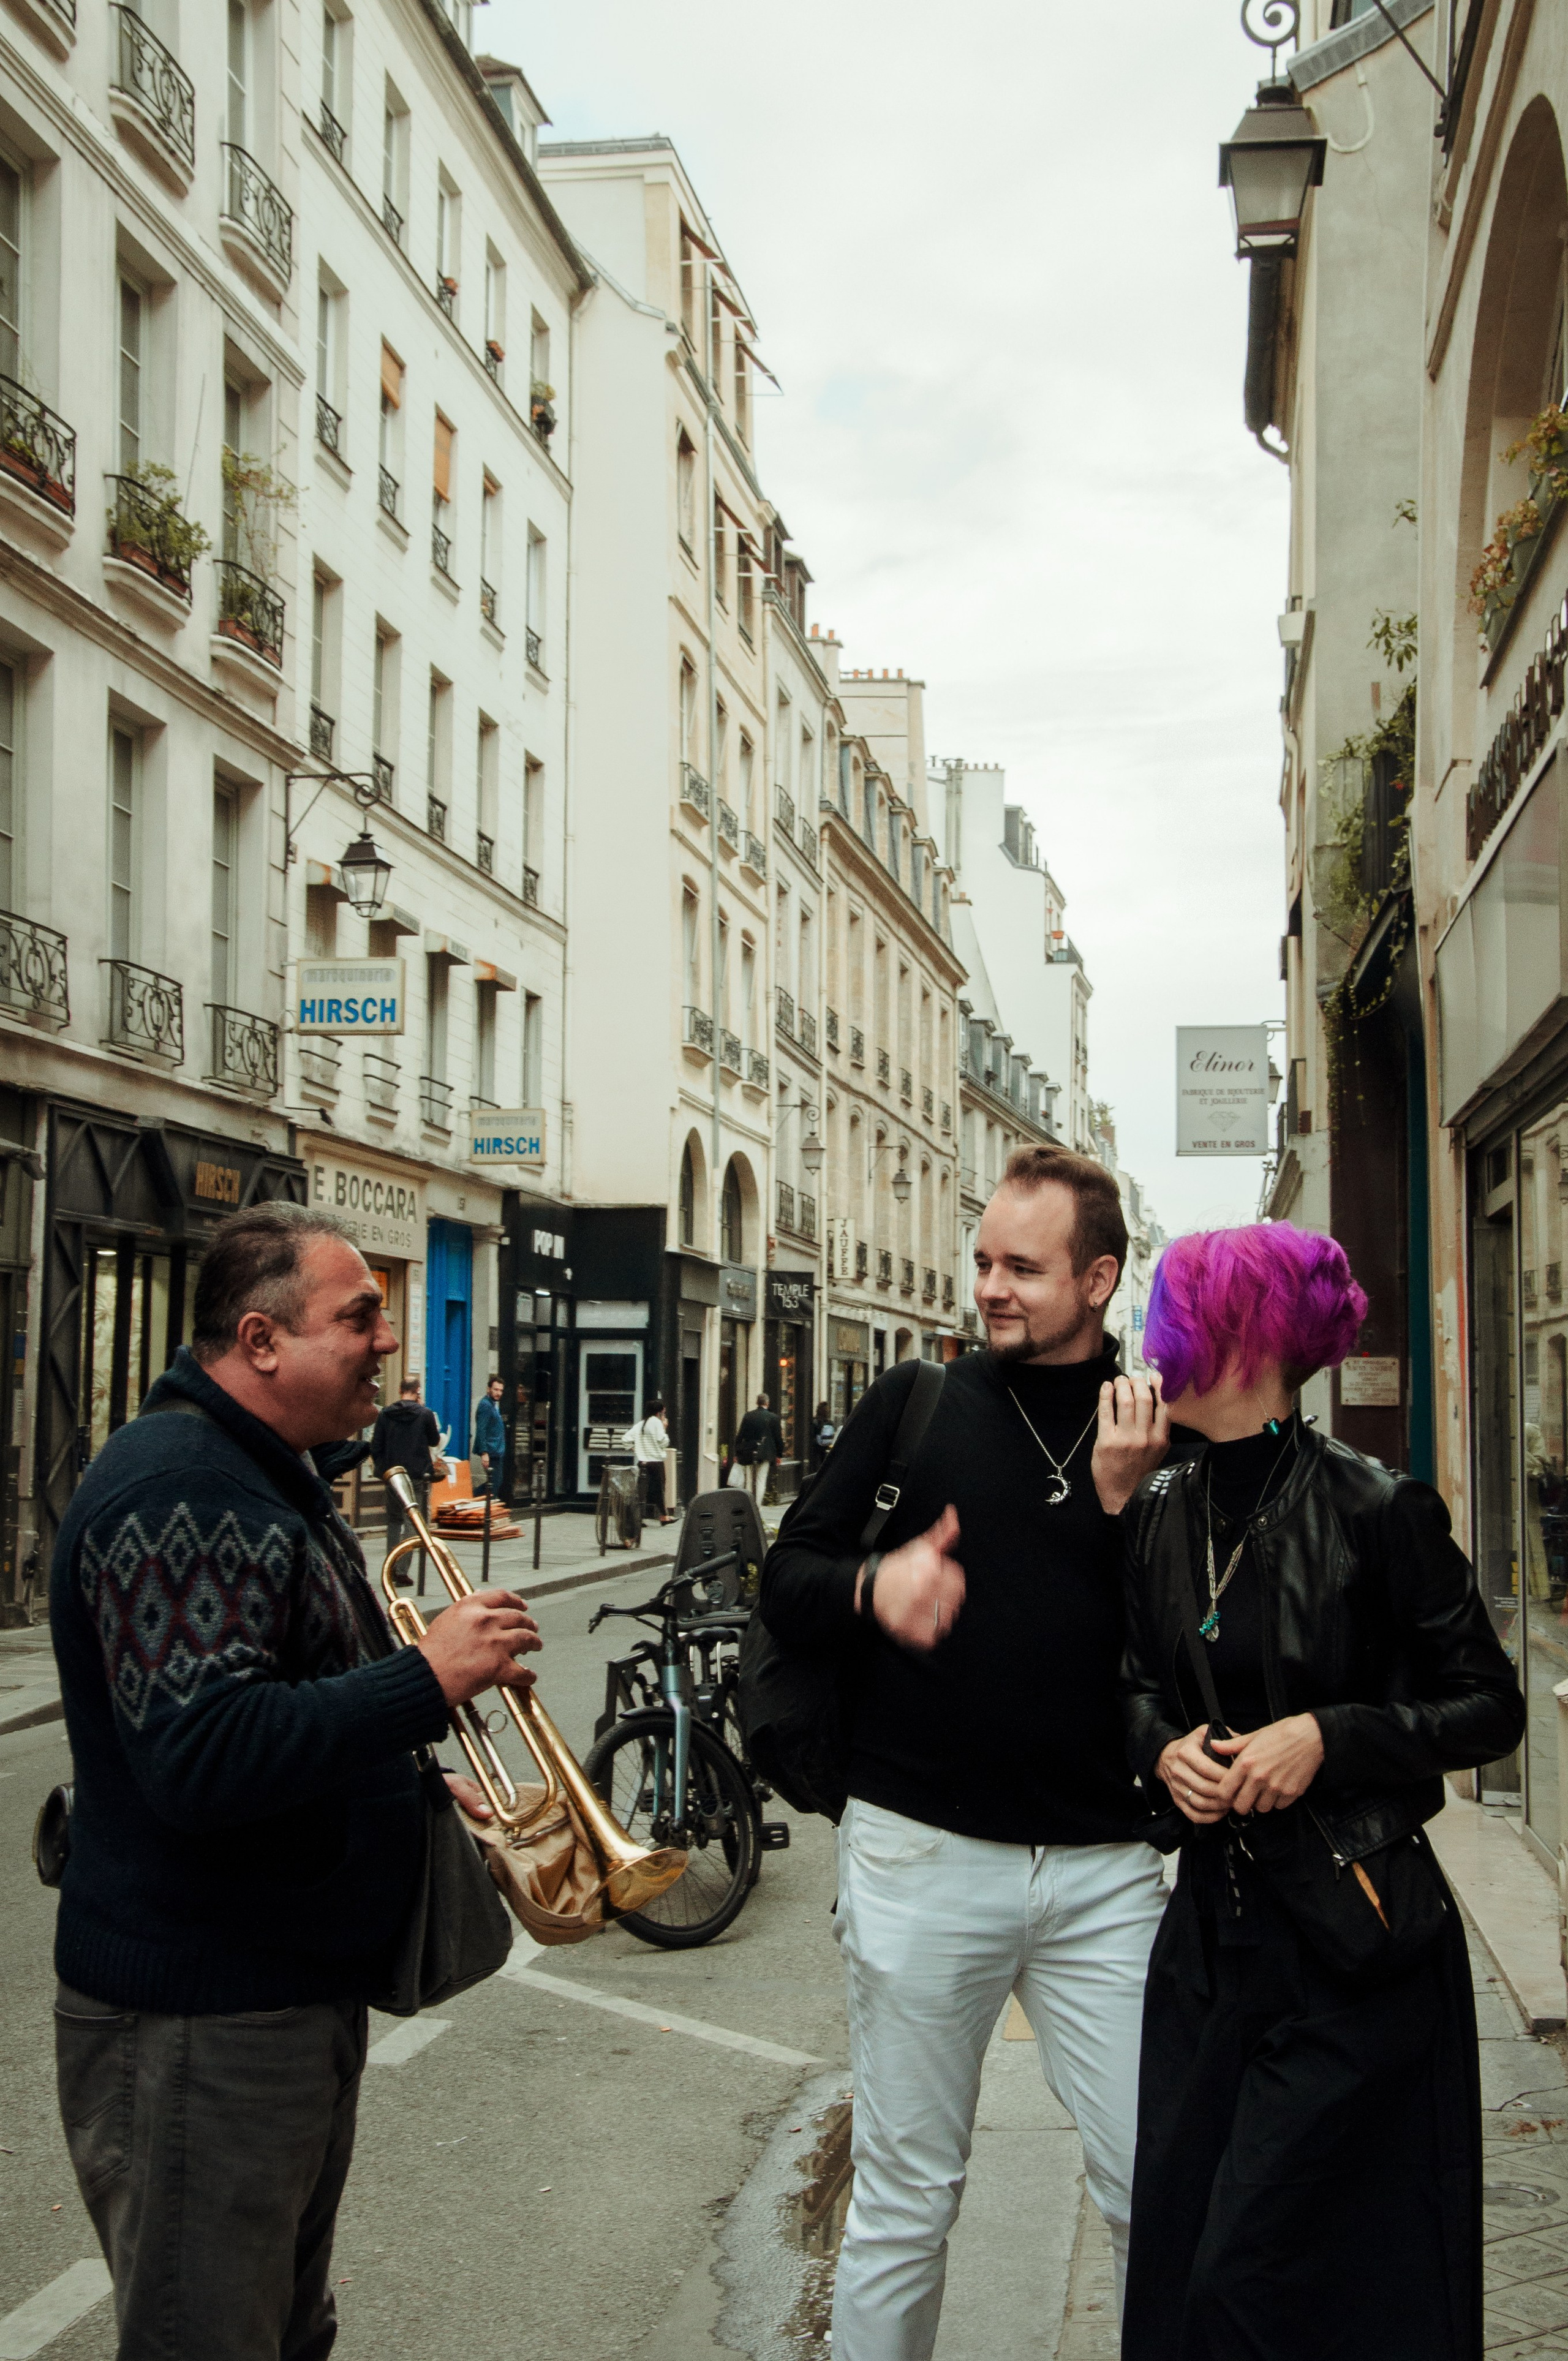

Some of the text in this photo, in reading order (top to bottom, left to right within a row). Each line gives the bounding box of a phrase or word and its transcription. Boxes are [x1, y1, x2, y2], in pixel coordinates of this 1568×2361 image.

[300, 998, 396, 1024] HIRSCH
[1190, 1051, 1254, 1072] Elinor
[473, 1137, 540, 1155] HIRSCH
[195, 1162, 241, 1204] HIRSCH
[372, 1226, 383, 1242] EN
[388, 1229, 413, 1249] GROS
[533, 1229, 553, 1256] POP
[772, 1283, 809, 1297] TEMPLE
[781, 1295, 799, 1309] 153
